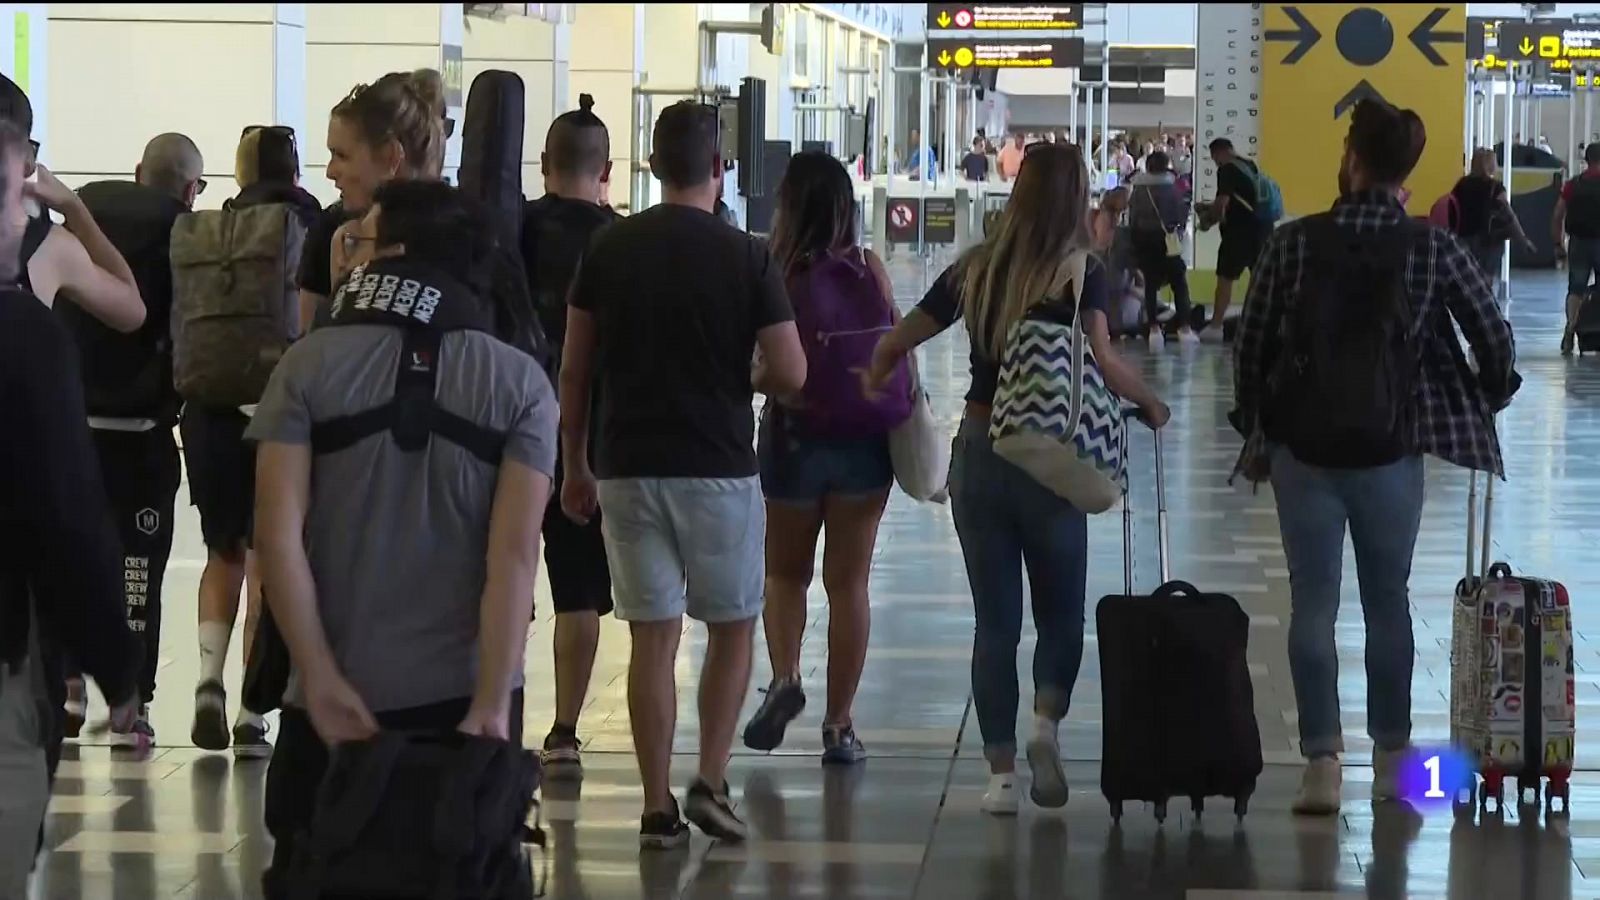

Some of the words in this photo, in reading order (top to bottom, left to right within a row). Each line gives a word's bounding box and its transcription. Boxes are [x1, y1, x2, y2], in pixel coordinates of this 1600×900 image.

[1250, 3, 1259, 73] encue
[1227, 29, 1238, 90] point
[371, 274, 399, 311] CREW
[391, 279, 421, 316] CREW
[412, 285, 442, 323] CREW
[124, 556, 148, 568] CREW
[124, 569, 148, 580] CREW
[124, 581, 147, 593] CREW
